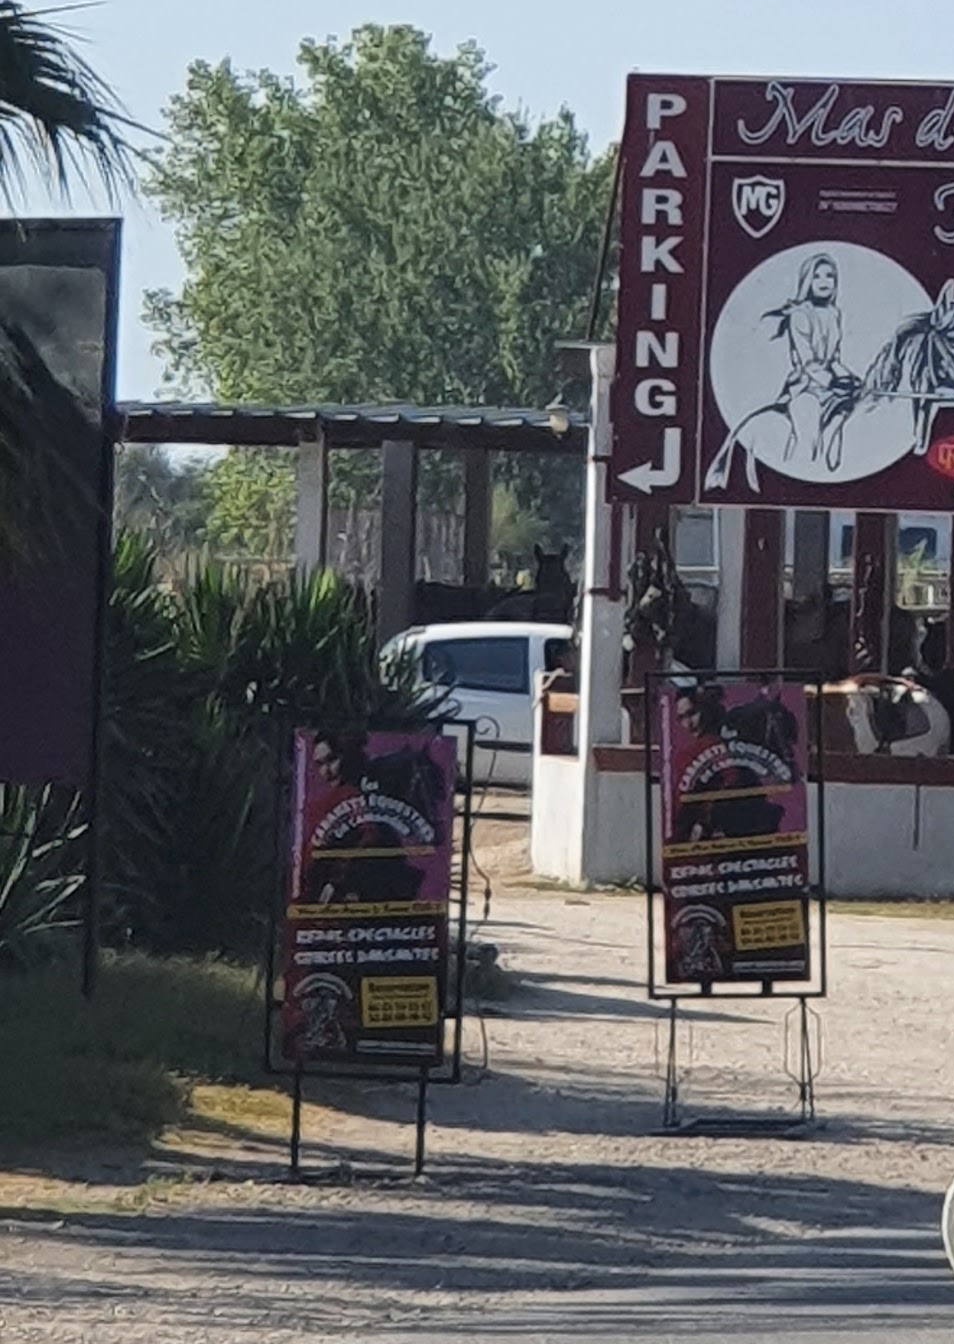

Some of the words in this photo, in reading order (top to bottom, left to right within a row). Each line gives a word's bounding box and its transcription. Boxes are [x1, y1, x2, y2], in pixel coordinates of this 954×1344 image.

[738, 81, 903, 147] Mas
[740, 185, 779, 217] MG
[633, 92, 688, 417] PARKING
